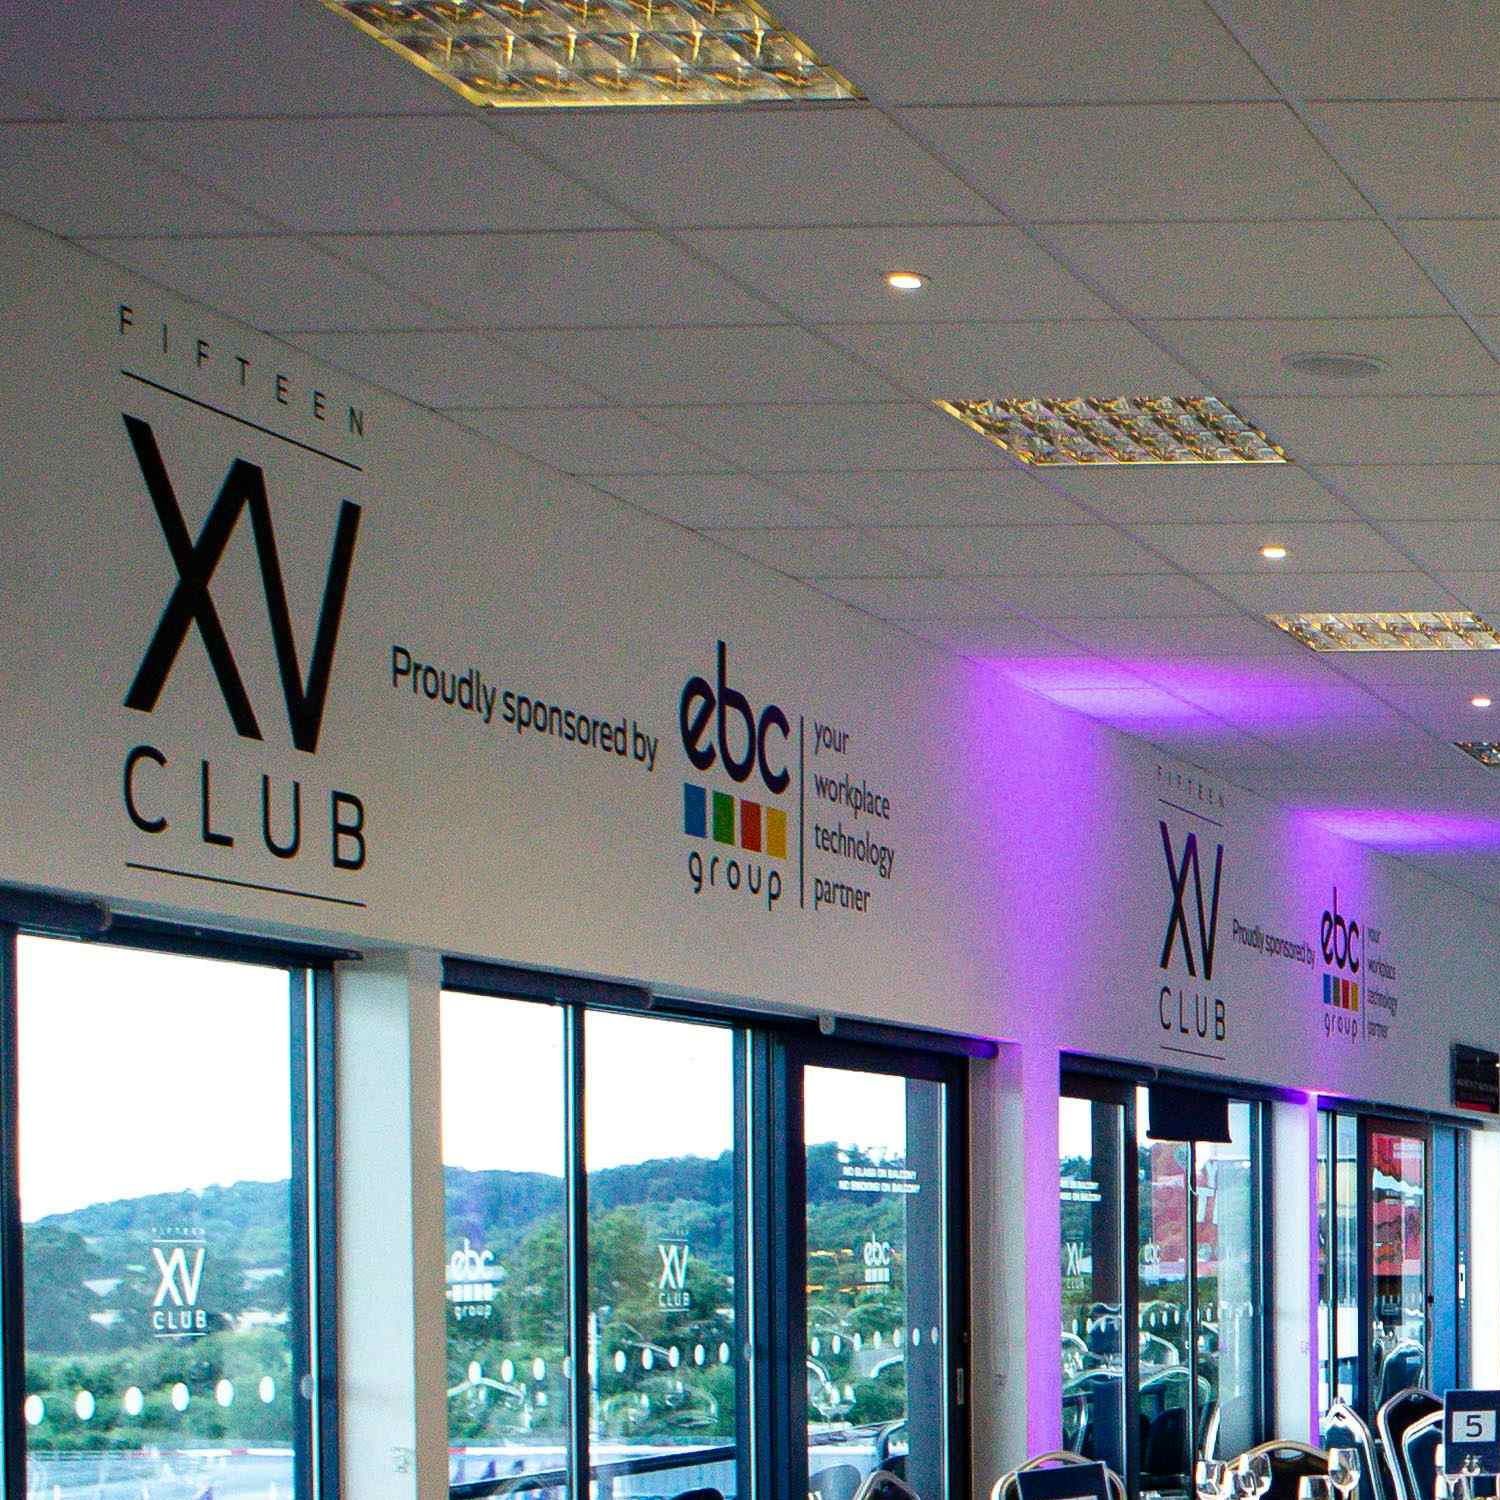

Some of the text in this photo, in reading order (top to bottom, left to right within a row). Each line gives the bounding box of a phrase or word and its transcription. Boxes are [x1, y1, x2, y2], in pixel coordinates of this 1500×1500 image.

[119, 306, 365, 437] FIFTEEN
[121, 412, 363, 754] XV
[392, 645, 659, 772] Proudly sponsored by
[679, 639, 790, 794] ebc
[814, 721, 850, 756] your
[123, 745, 367, 871] CLUB
[814, 773, 890, 820] workplace
[814, 822, 895, 880] technology
[688, 851, 782, 912] group
[814, 876, 871, 913] partner
[1159, 820, 1224, 981] XV
[1320, 886, 1360, 973] ebc
[1159, 985, 1226, 1041] CLUB
[1324, 1012, 1359, 1044] group
[151, 1247, 206, 1307] XV
[657, 1244, 689, 1290] XV
[152, 1309, 207, 1330] CLUB
[659, 1292, 691, 1307] CLUB
[1466, 1414, 1483, 1438] 5
